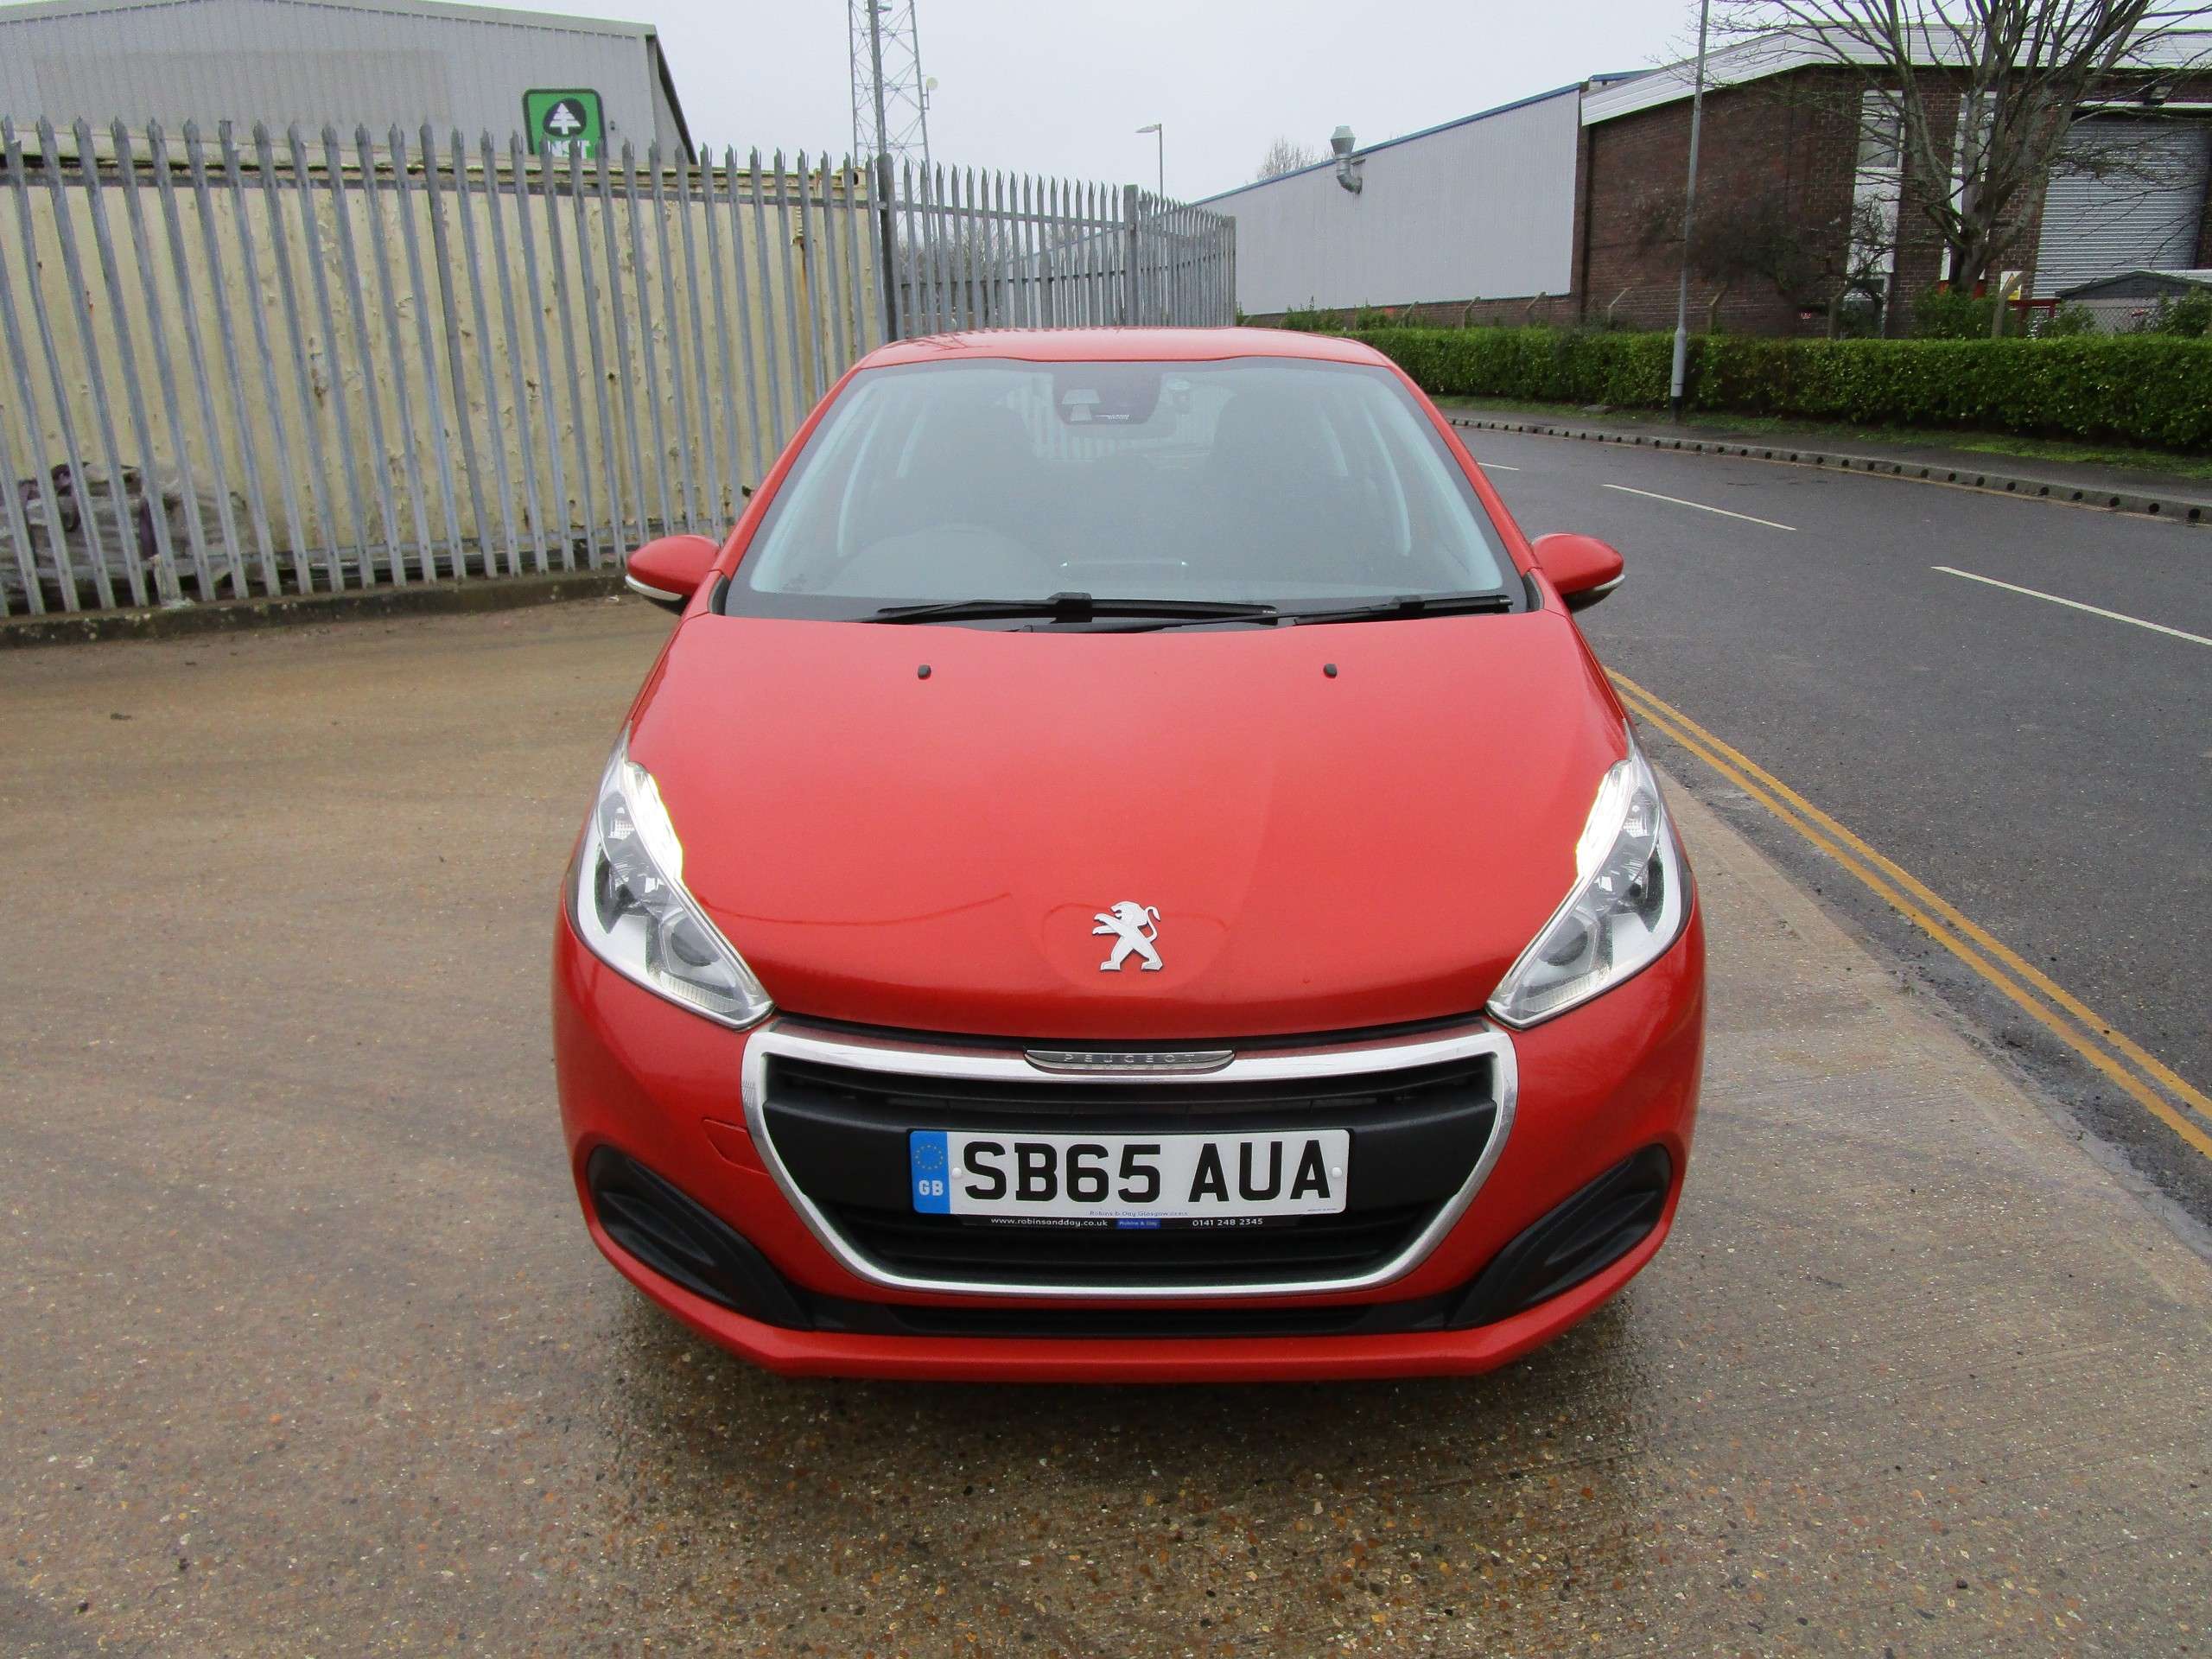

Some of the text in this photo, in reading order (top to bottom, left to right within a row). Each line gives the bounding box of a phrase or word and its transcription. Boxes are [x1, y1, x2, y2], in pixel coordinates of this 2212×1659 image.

[963, 1140, 1331, 1204] SB65 AUA
[918, 1179, 944, 1196] GB
[991, 1217, 1108, 1227] www.robinsandday.co.uk
